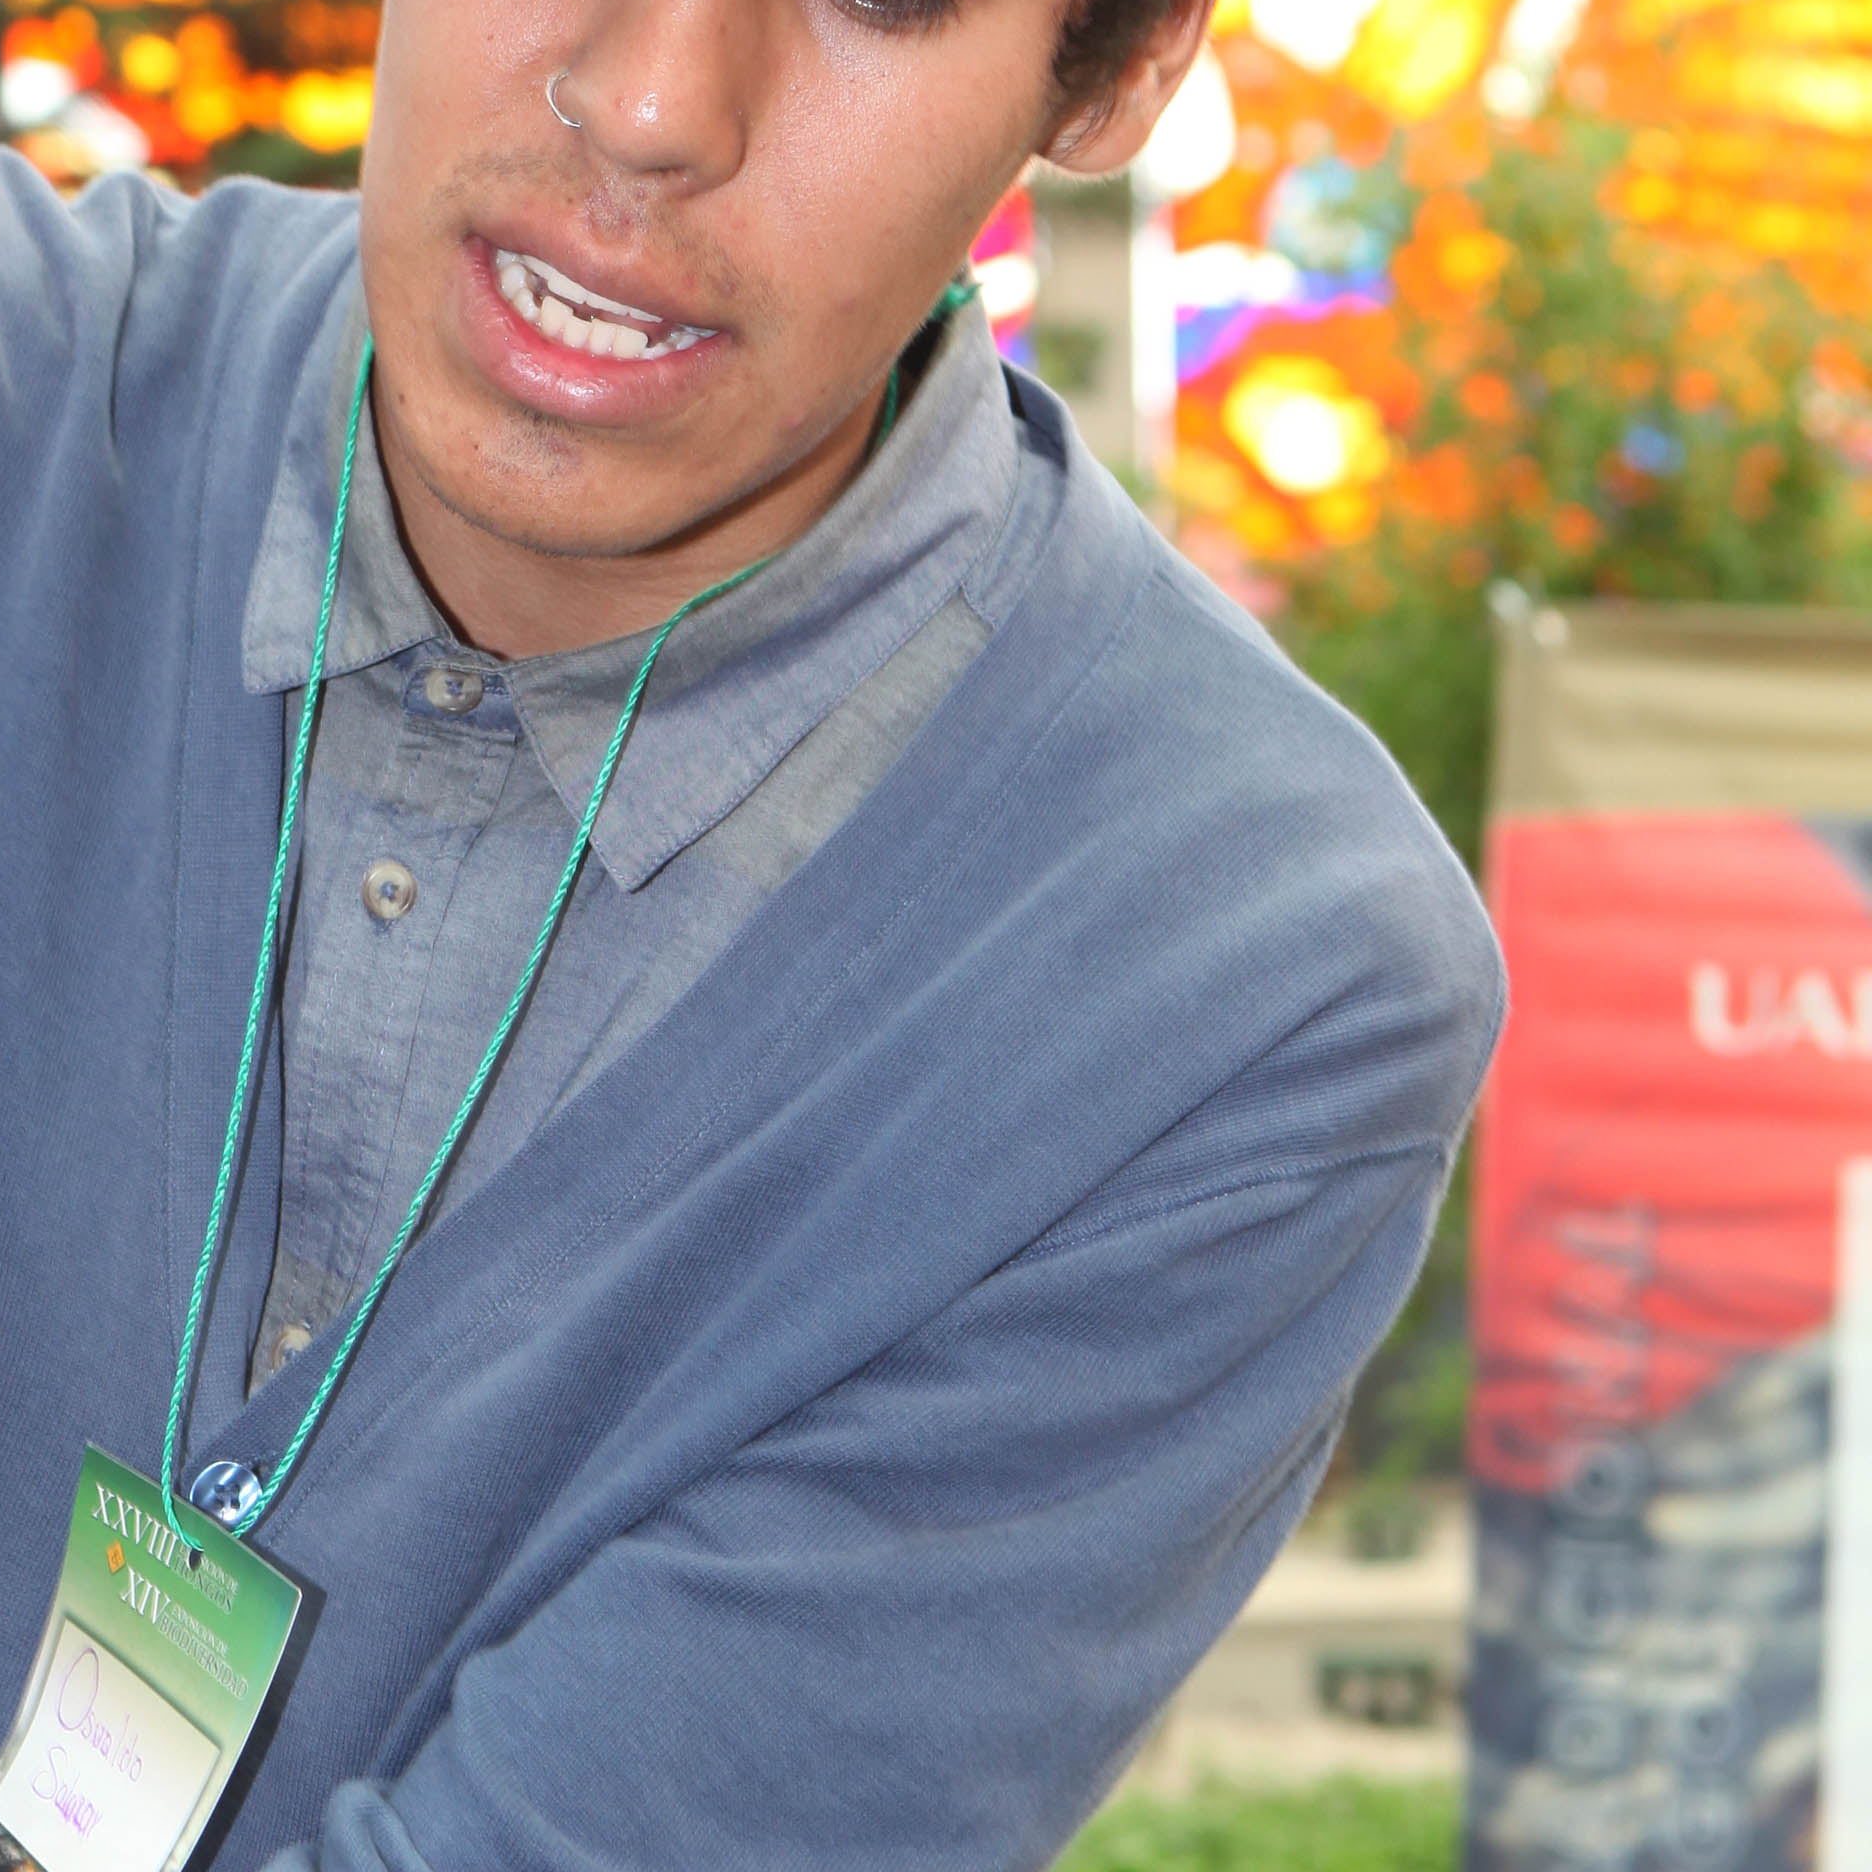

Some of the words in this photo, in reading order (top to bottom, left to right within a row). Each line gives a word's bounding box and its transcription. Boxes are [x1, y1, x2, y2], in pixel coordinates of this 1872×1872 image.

[92, 1481, 179, 1568] XXVIII
[120, 1565, 172, 1625] XIV
[172, 1555, 233, 1616] HONGOS
[159, 1612, 248, 1699] BIODIVERSIDAD
